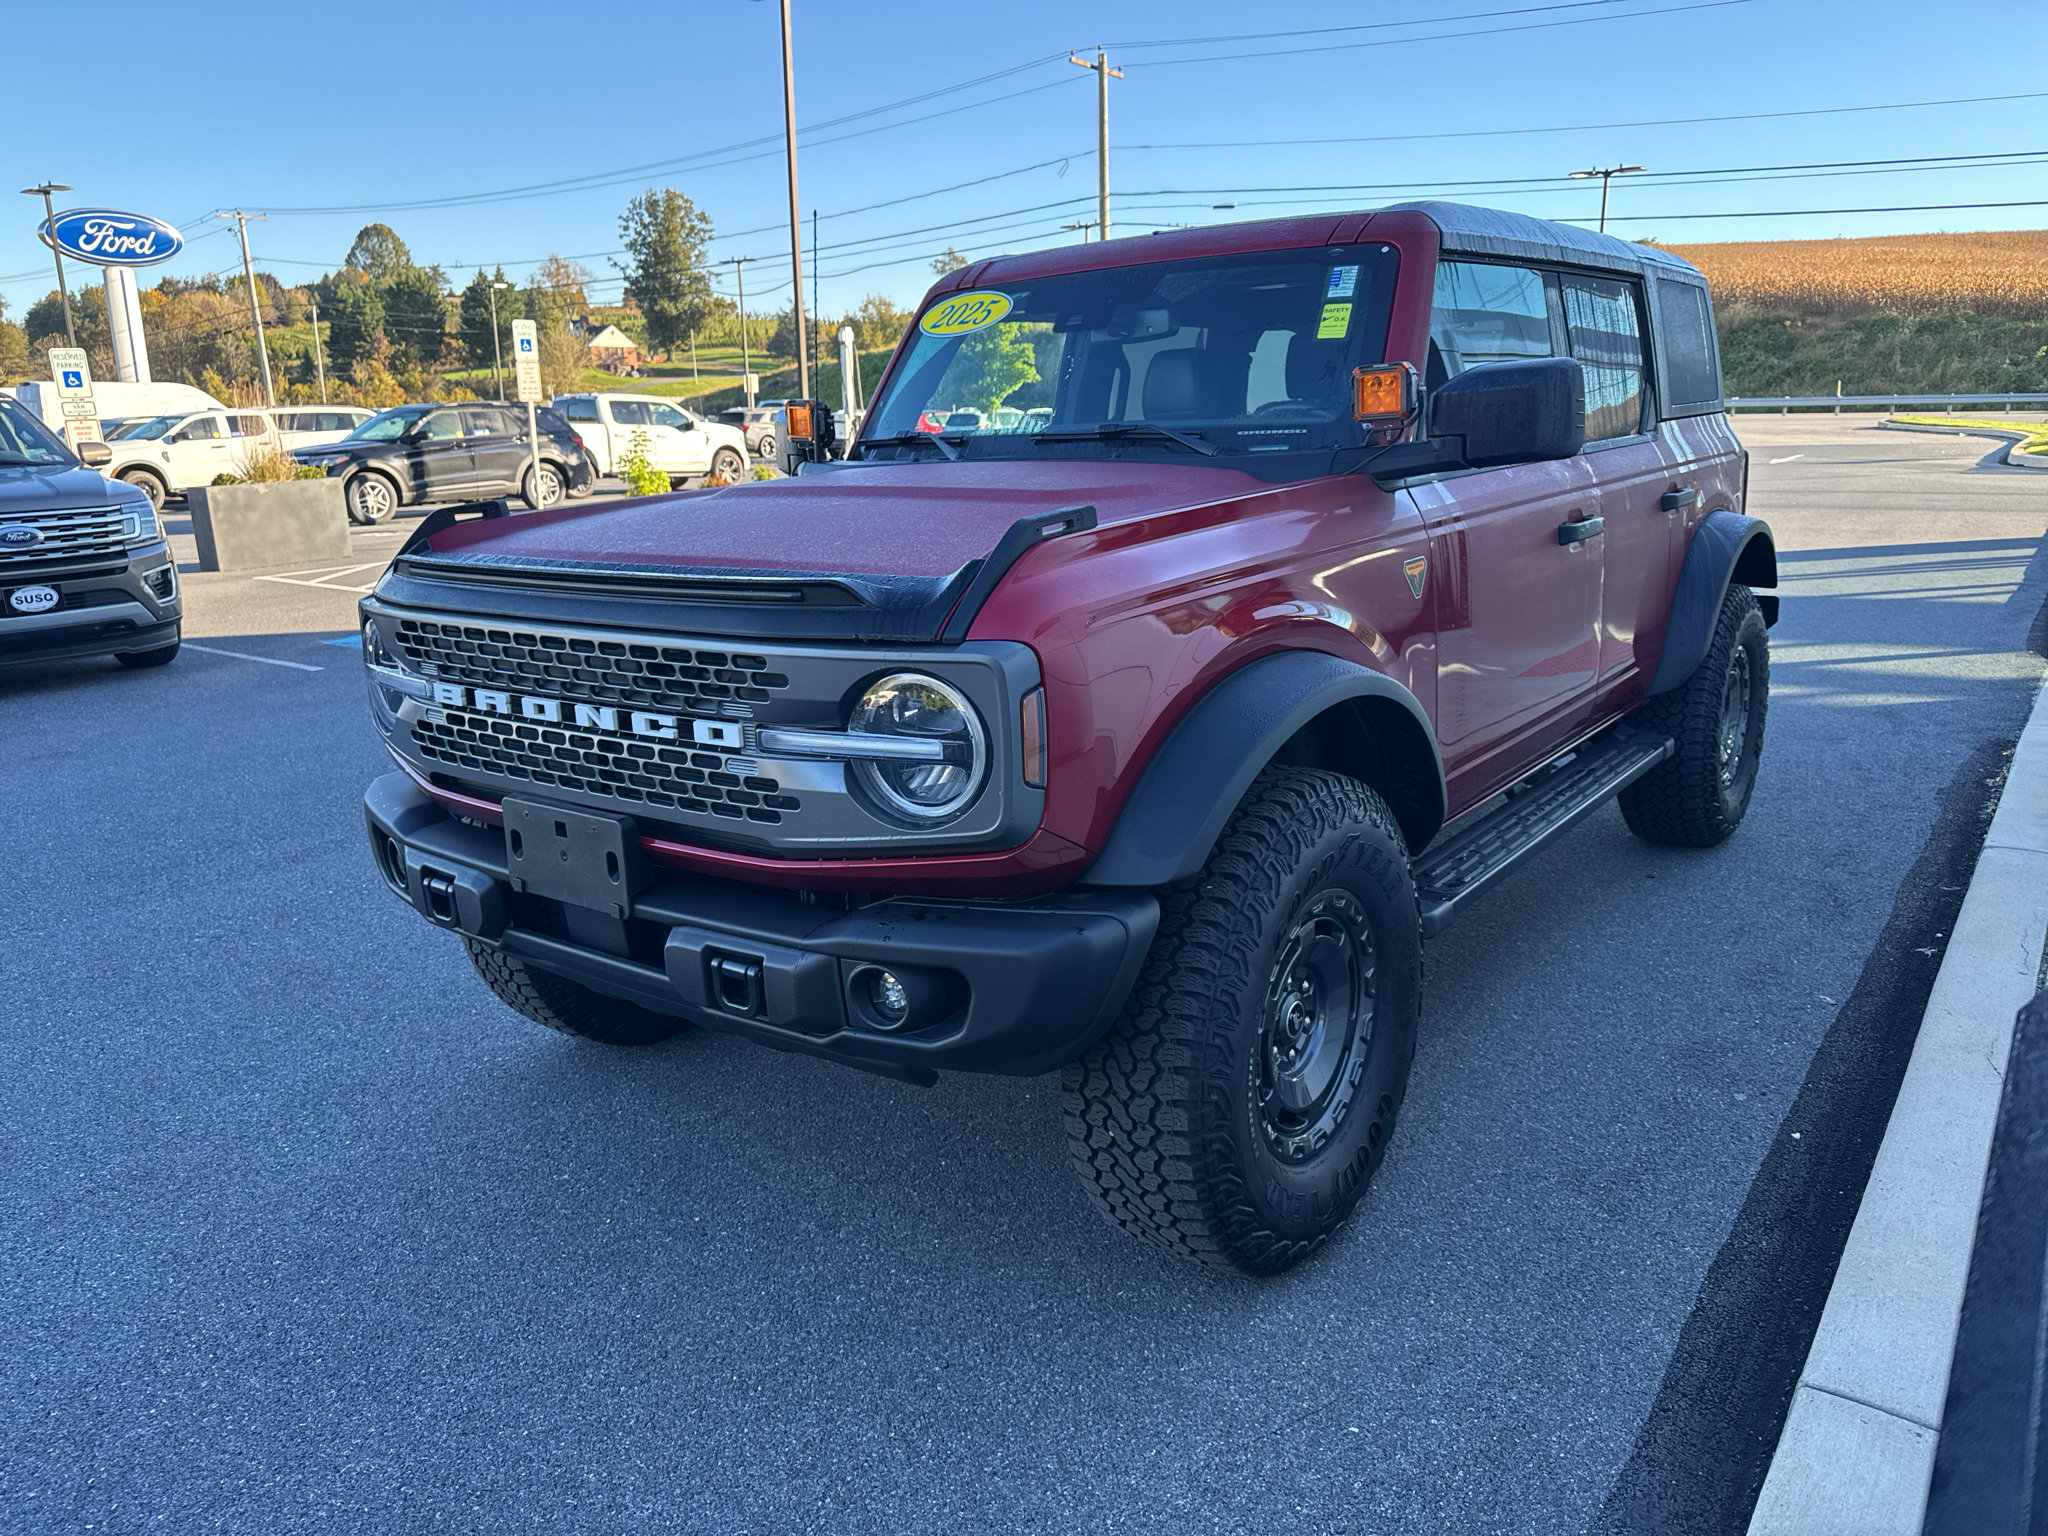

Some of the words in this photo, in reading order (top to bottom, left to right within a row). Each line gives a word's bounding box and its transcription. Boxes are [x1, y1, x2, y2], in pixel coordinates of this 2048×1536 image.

[78, 218, 156, 255] Ford
[929, 299, 1002, 329] 2025
[6, 532, 31, 541] Ford
[14, 592, 54, 605] SUSQ
[433, 681, 746, 749] BRONCO
